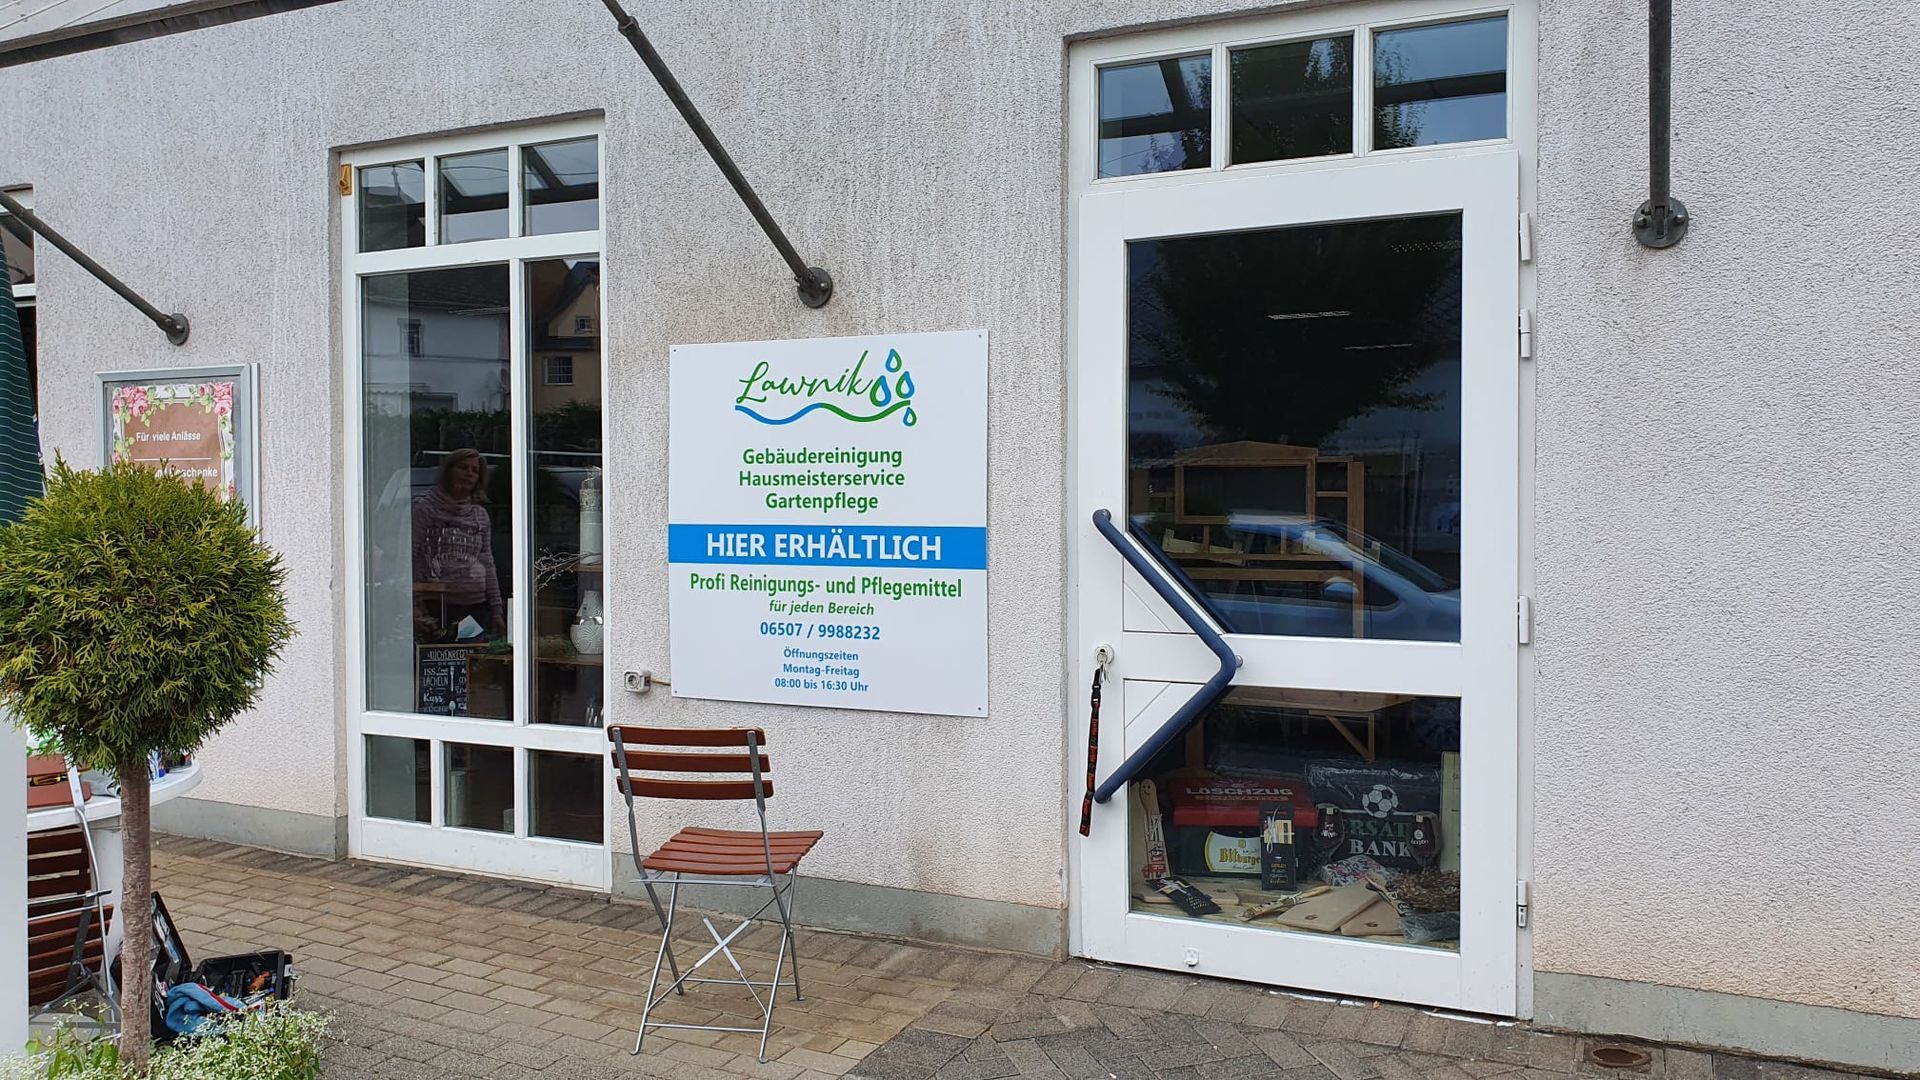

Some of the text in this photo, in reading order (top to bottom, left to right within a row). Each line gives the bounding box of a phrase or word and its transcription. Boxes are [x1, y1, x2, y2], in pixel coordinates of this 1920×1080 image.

[735, 350, 875, 404] Lawnik
[136, 431, 201, 442] Für viele Anlässe
[742, 446, 903, 468] Gebäudereinigung
[739, 469, 905, 487] Hausmeisterservice
[765, 492, 879, 513] Gartenpflege
[706, 527, 942, 561] HIER ERHÄLTLICH
[690, 572, 962, 600] Profi Reinigungs- und Pflegemittel
[768, 600, 875, 616] für jeden Bereich
[759, 621, 881, 640] 06507 / 9988232
[783, 647, 859, 662] Öffnungszeiten
[782, 662, 860, 678] Montag-Freitag
[774, 677, 869, 692] 08:00 bis 16:30 Uhr
[1347, 819, 1409, 838] RSAT
[1218, 848, 1262, 866] Bitburge
[1348, 838, 1411, 857] BANK
